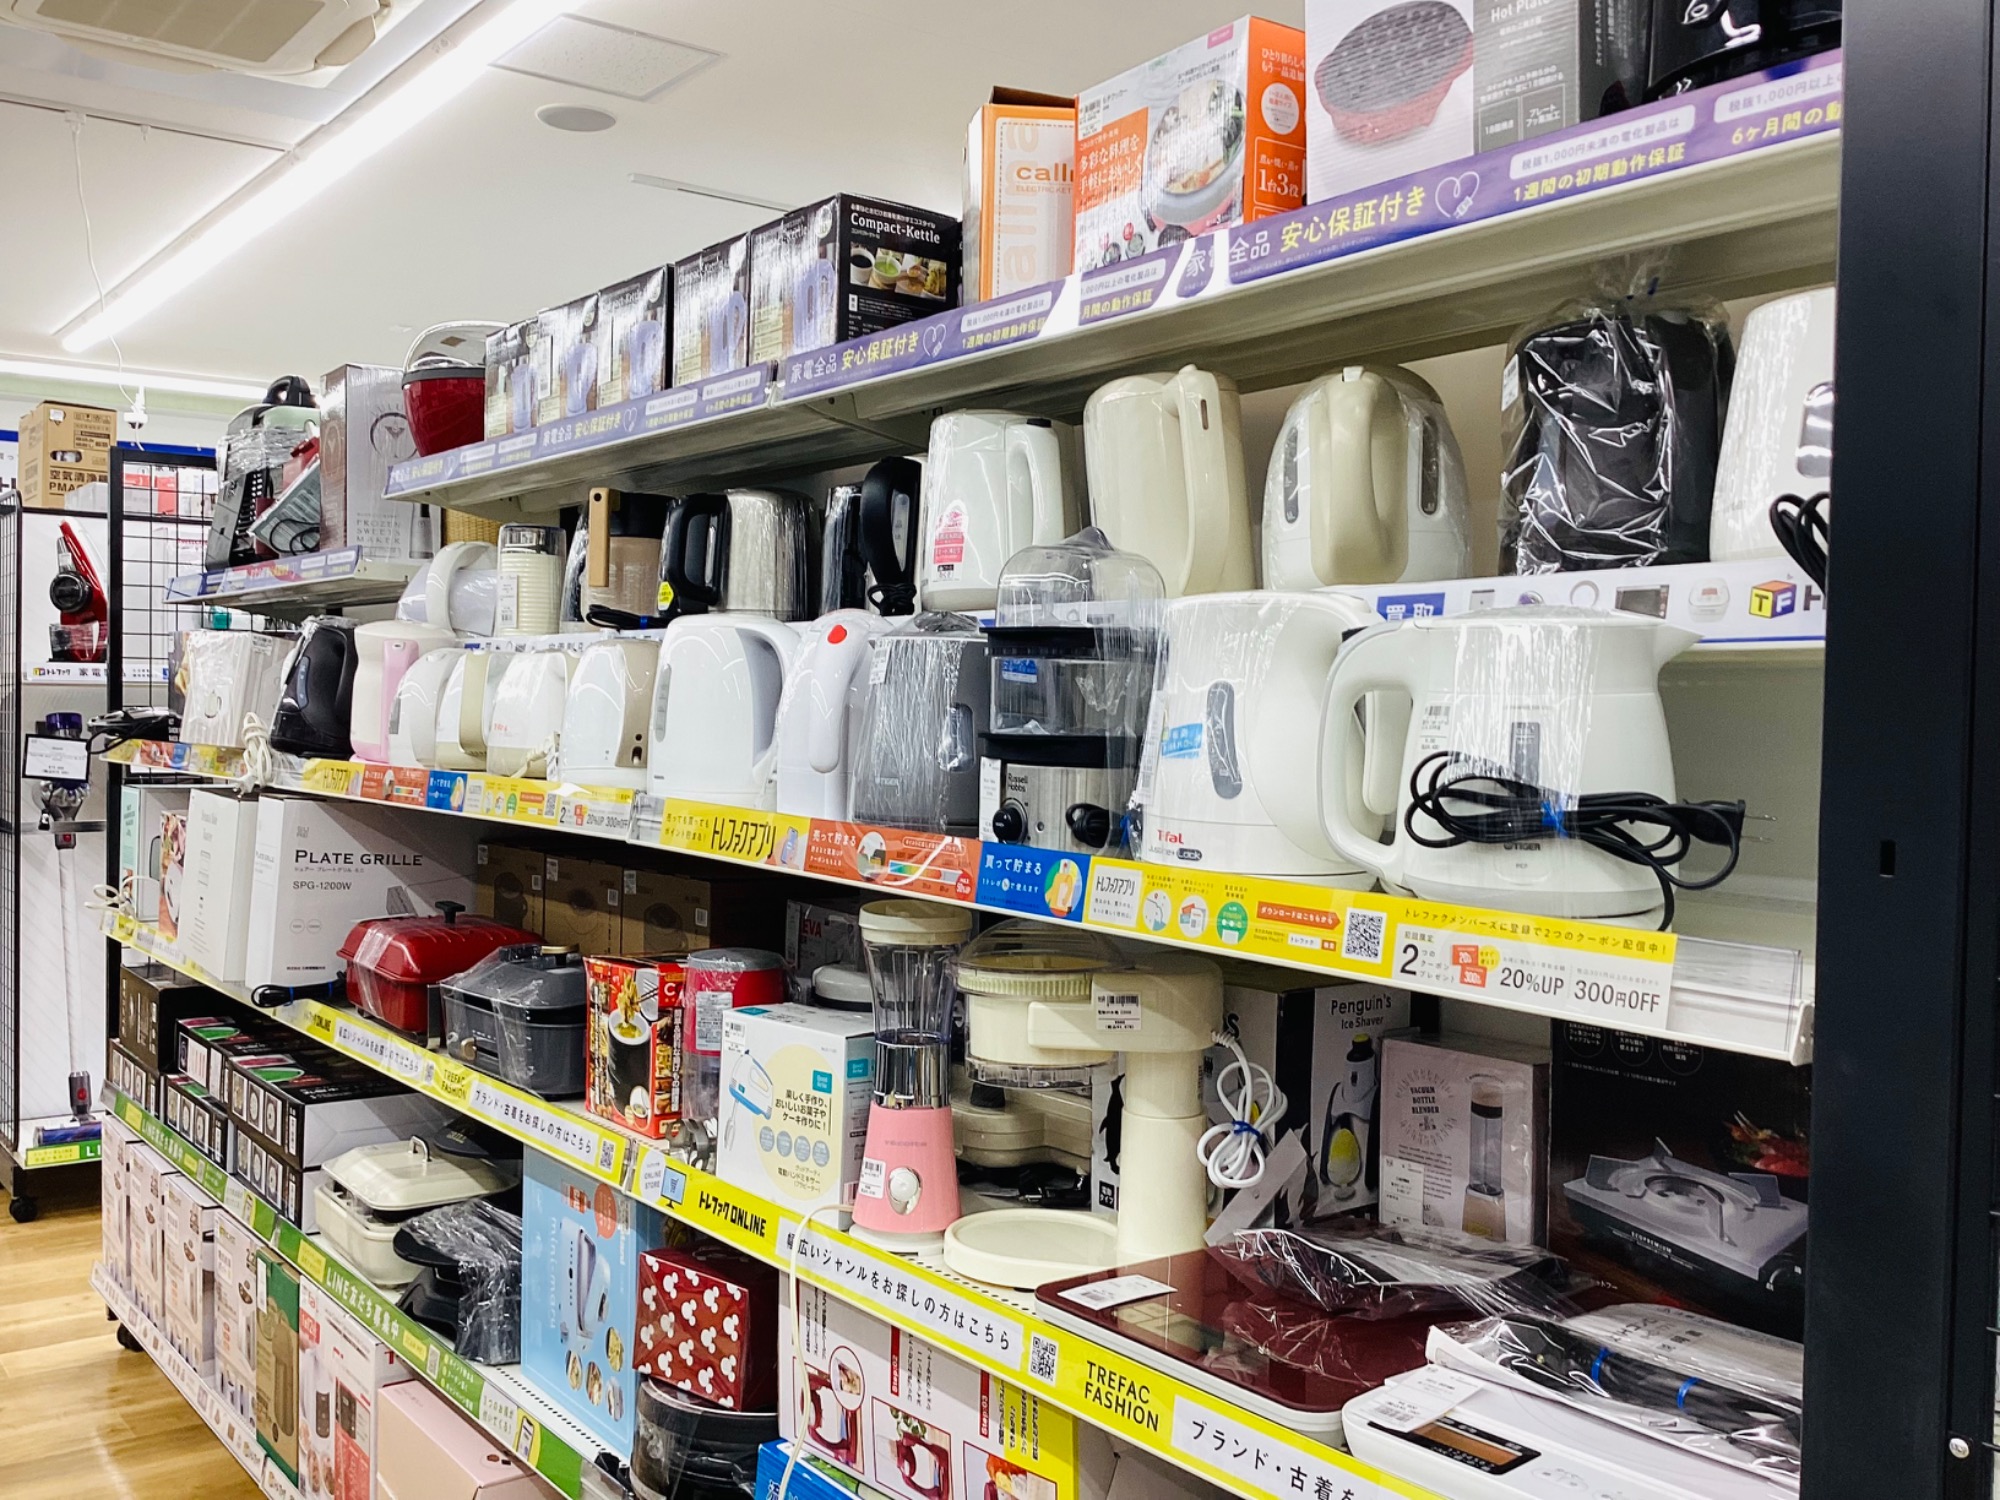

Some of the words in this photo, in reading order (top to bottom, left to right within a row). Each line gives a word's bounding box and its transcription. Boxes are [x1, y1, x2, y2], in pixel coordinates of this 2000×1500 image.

[1491, 6, 1517, 24] Hot
[1080, 133, 1140, 173] 多彩な料理を
[1259, 168, 1299, 198] 1台3役
[1513, 142, 1685, 203] 1週間の初期動作保証
[851, 212, 940, 244] Compact-Kettle
[1281, 187, 1426, 253] 安心保証付き
[790, 352, 837, 384] 家電全品
[841, 331, 919, 371] 安心保証付き
[711, 816, 776, 860] トレファクアプリ
[812, 829, 857, 847] 売って貯まる
[1514, 842, 1541, 851] TIGER
[295, 849, 354, 866] PLATE
[360, 854, 423, 867] GRILLE
[984, 854, 1042, 876] 買って貯まる
[292, 880, 353, 891] SPG-1200W
[1096, 875, 1136, 897] トレファクアプリ
[1260, 906, 1334, 926] ダウンロードはこちらから
[1404, 930, 1434, 943] 初回限定
[1400, 943, 1419, 977] 2
[1421, 949, 1436, 958] つの
[1420, 959, 1450, 971] クーポン
[1499, 967, 1565, 996] 20%UP
[1574, 979, 1662, 1013] 300円OFF
[1330, 994, 1392, 1017] Penguin's
[1341, 1018, 1354, 1030] Ice
[1355, 1015, 1385, 1029] Shaver
[786, 1088, 828, 1108] 楽しく手作り、
[1410, 1086, 1436, 1095] VACUUM
[1412, 1096, 1436, 1104] BOTTLE
[775, 1098, 827, 1119] おいしいお菓子や
[1411, 1106, 1440, 1114] BLENDER
[474, 1088, 593, 1156] ブランド・古着をお探しの方はこちら
[643, 1169, 663, 1181] ONLINE
[644, 1179, 661, 1190] STORE
[777, 1167, 820, 1184] 電動ハンドミキサー
[698, 1190, 729, 1222] トレファク
[729, 1206, 768, 1239] ONLINE
[326, 1266, 399, 1341] LINE友だち募集中
[1086, 1360, 1152, 1405] TREFAC
[1084, 1386, 1160, 1433] FASHION
